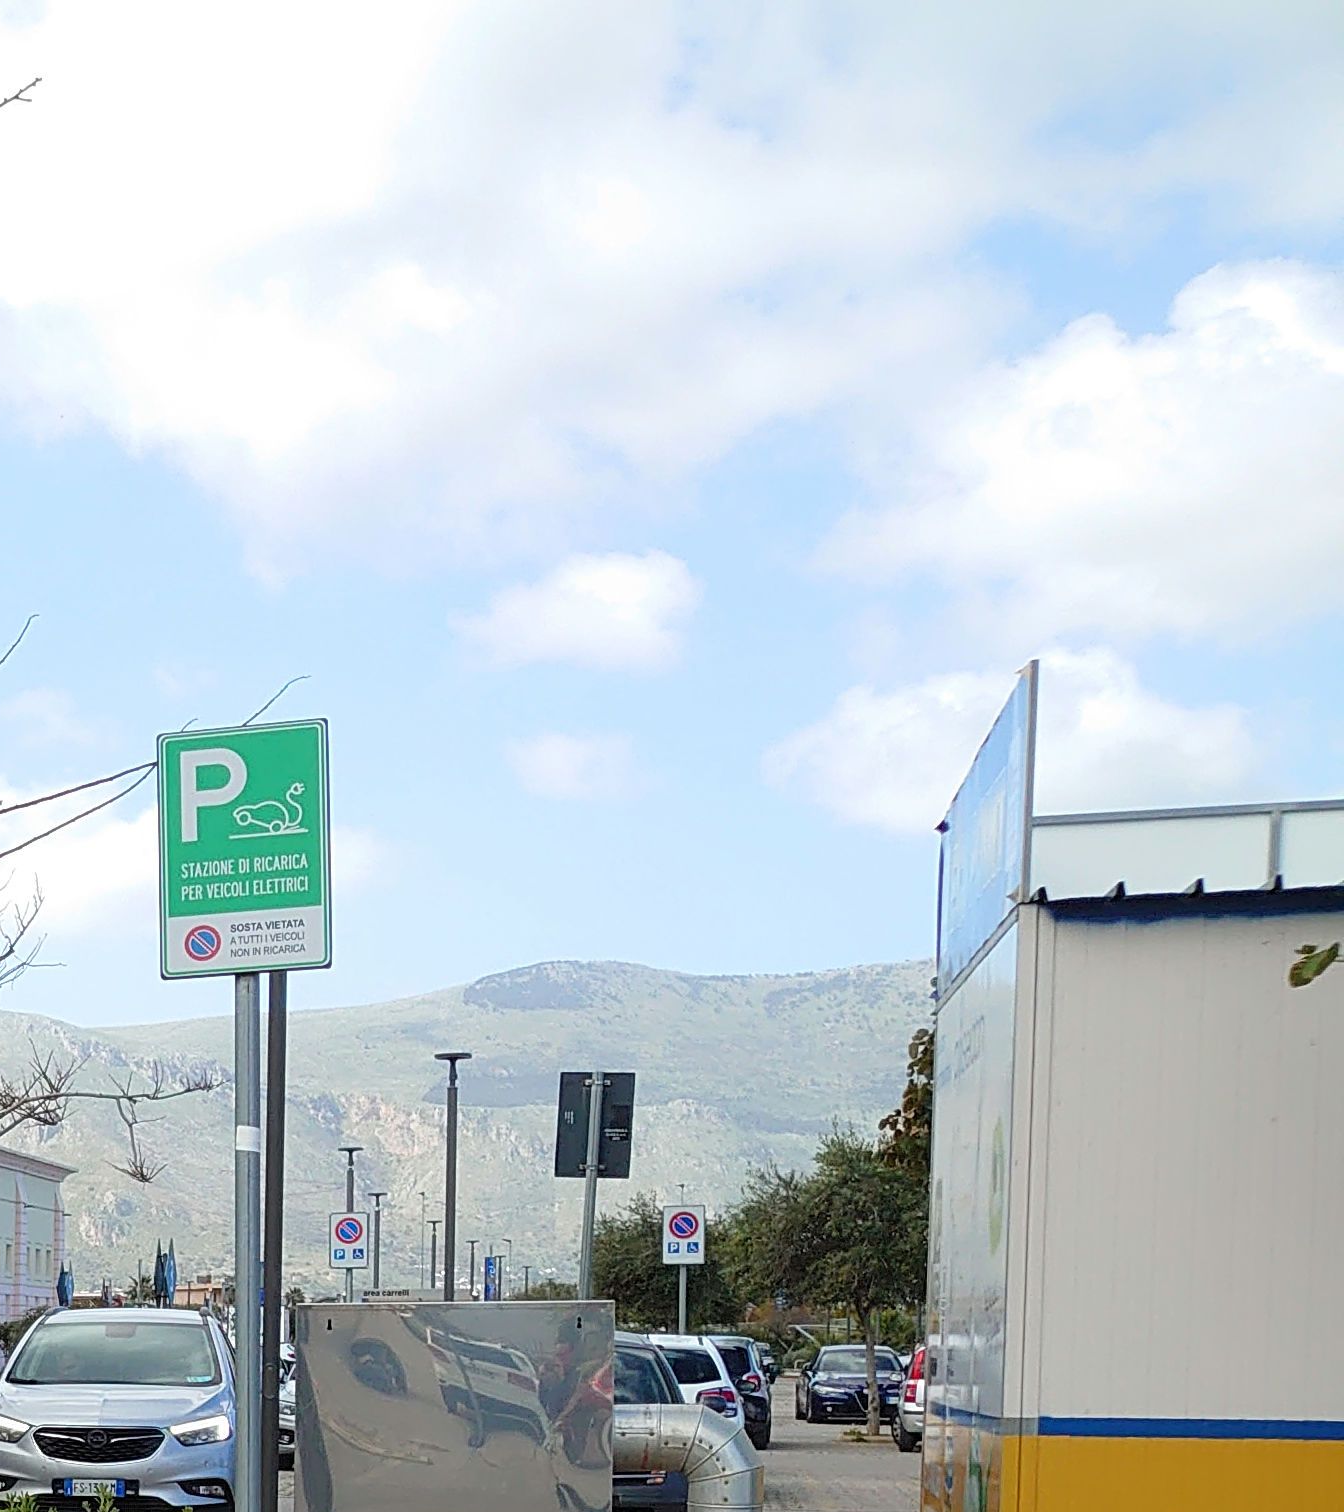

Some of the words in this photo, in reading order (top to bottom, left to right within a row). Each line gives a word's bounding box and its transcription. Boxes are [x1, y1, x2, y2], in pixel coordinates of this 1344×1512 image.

[179, 747, 248, 843] P
[181, 859, 235, 879] STAZIONE
[238, 858, 250, 874] DI
[253, 853, 309, 873] RICARICA
[181, 884, 203, 902] PER
[206, 881, 250, 899] VEICOLI
[253, 876, 309, 896] ELETTRICI
[230, 922, 263, 933] SOSTA
[265, 918, 305, 930] VIETATA
[230, 936, 237, 945] A
[238, 934, 263, 945] TUTTI
[269, 931, 305, 942] VEICOLI
[230, 948, 250, 958] NON
[252, 946, 261, 956] IN
[263, 943, 306, 956] RICARICA
